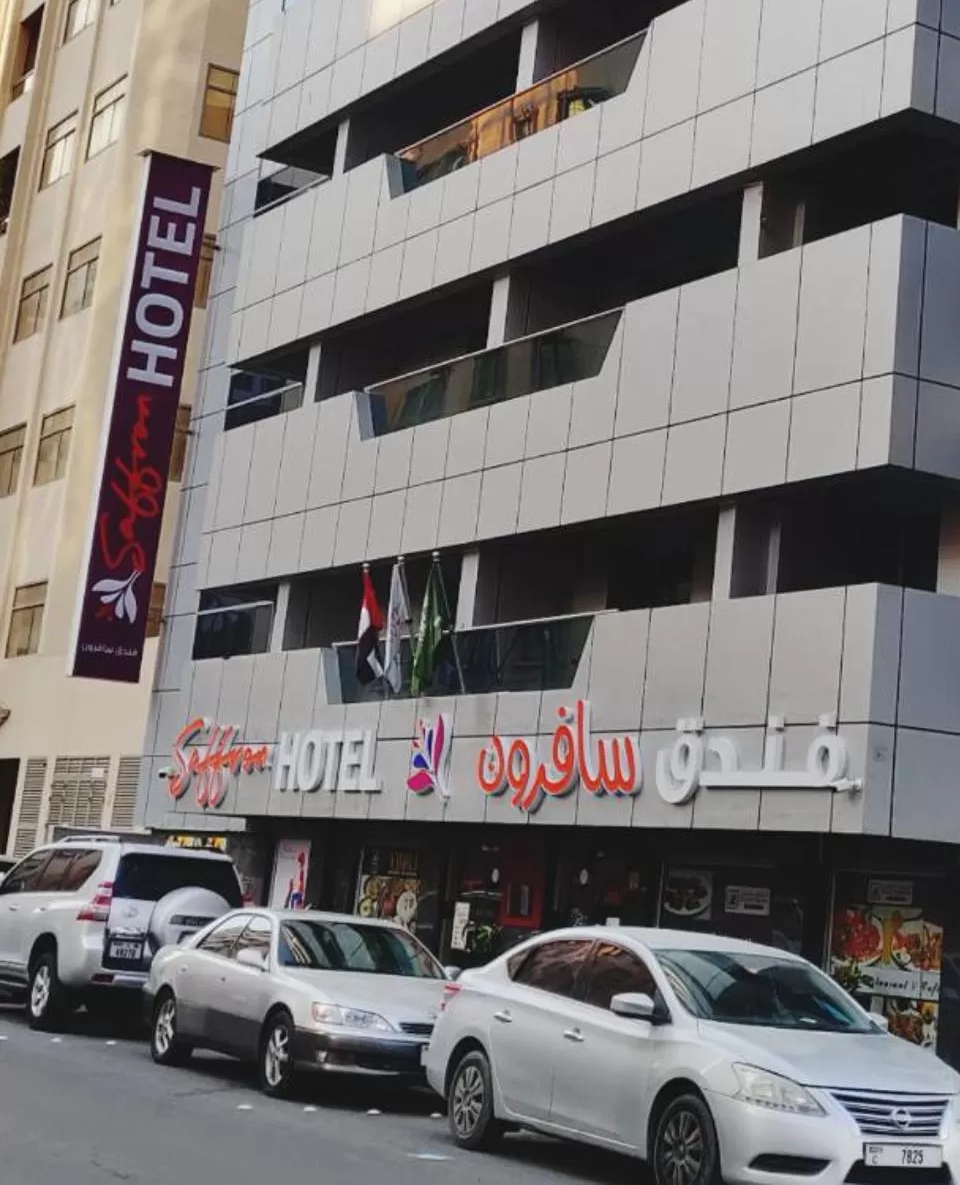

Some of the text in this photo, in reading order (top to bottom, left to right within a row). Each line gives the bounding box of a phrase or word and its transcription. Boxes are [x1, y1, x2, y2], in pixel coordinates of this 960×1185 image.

[99, 186, 202, 572] Saffron HOTEL
[167, 717, 382, 809] Saffron HOTEL
[476, 699, 852, 813] فندق سافرون
[902, 1149, 924, 1165] 7825
